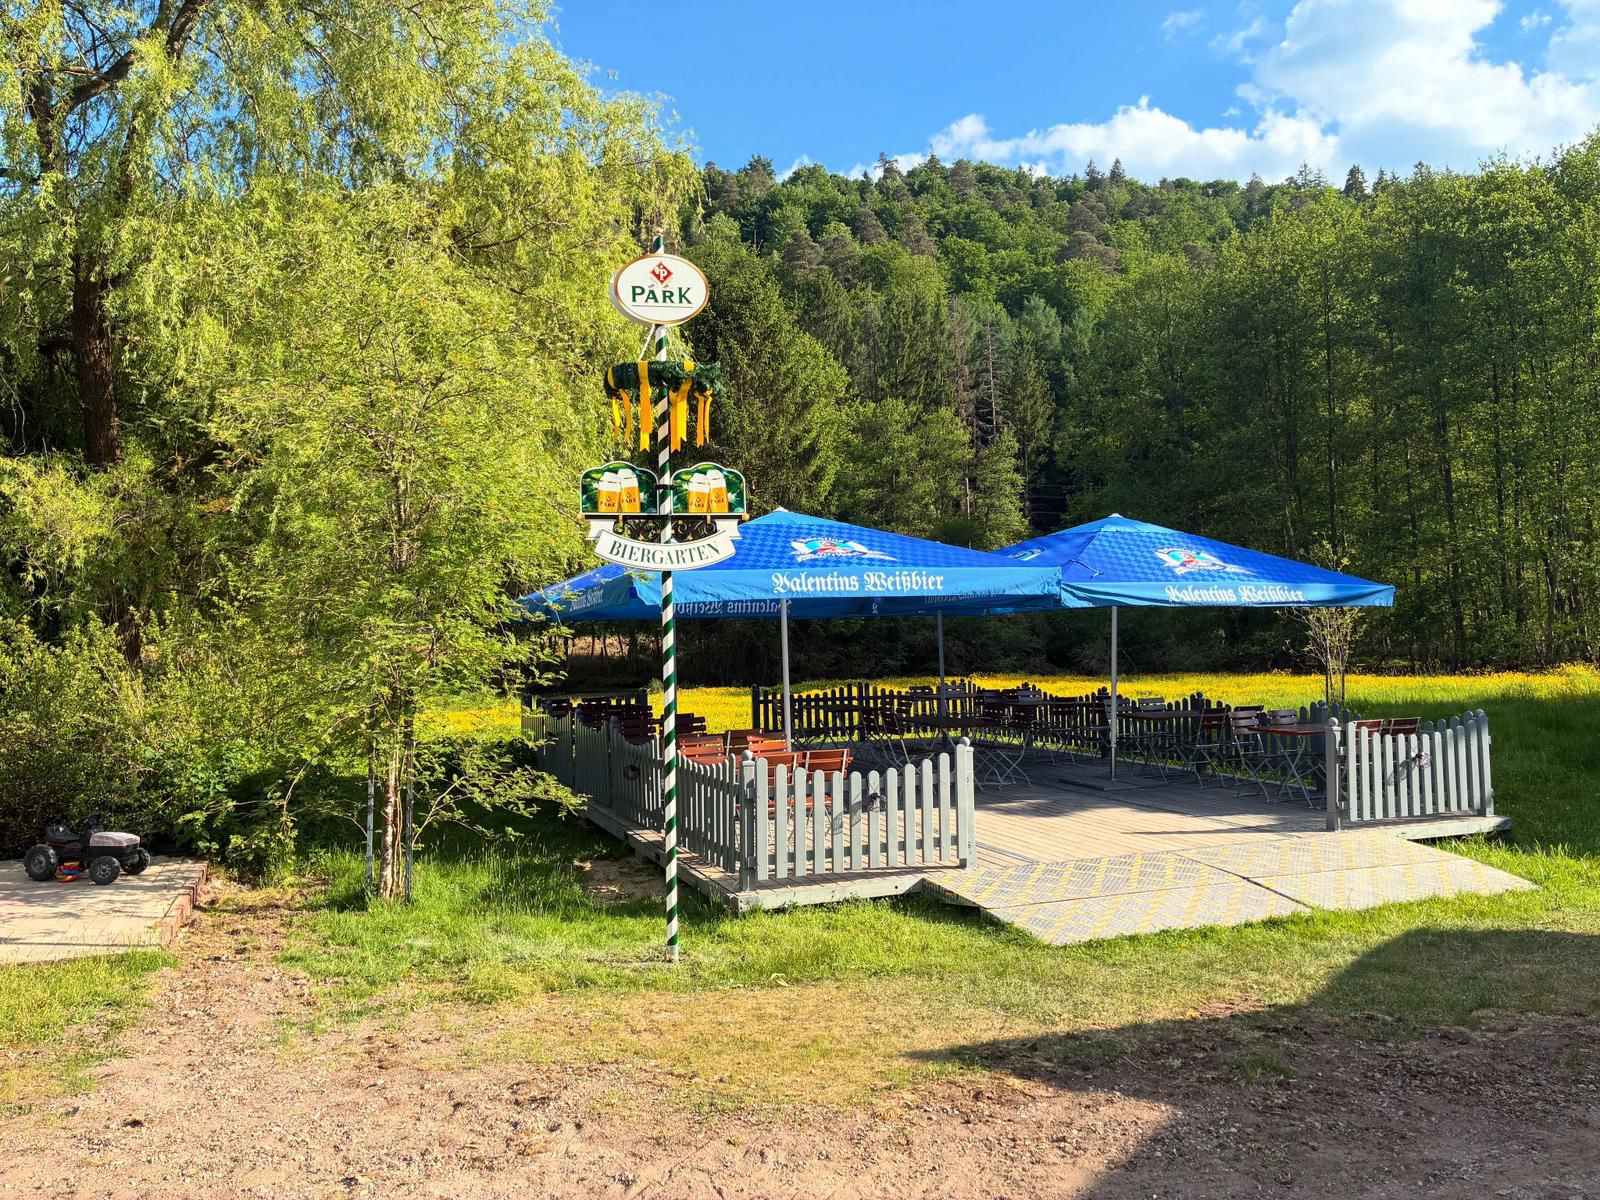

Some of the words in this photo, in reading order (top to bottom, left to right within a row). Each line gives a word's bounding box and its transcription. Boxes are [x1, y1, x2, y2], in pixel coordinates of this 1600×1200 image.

[631, 285, 692, 304] PARK
[609, 540, 721, 565] BIERGARTEN
[771, 571, 859, 593] Valentins
[864, 570, 944, 592] Weißbier
[1165, 585, 1237, 603] Valentins
[1238, 585, 1309, 602] Weißbier
